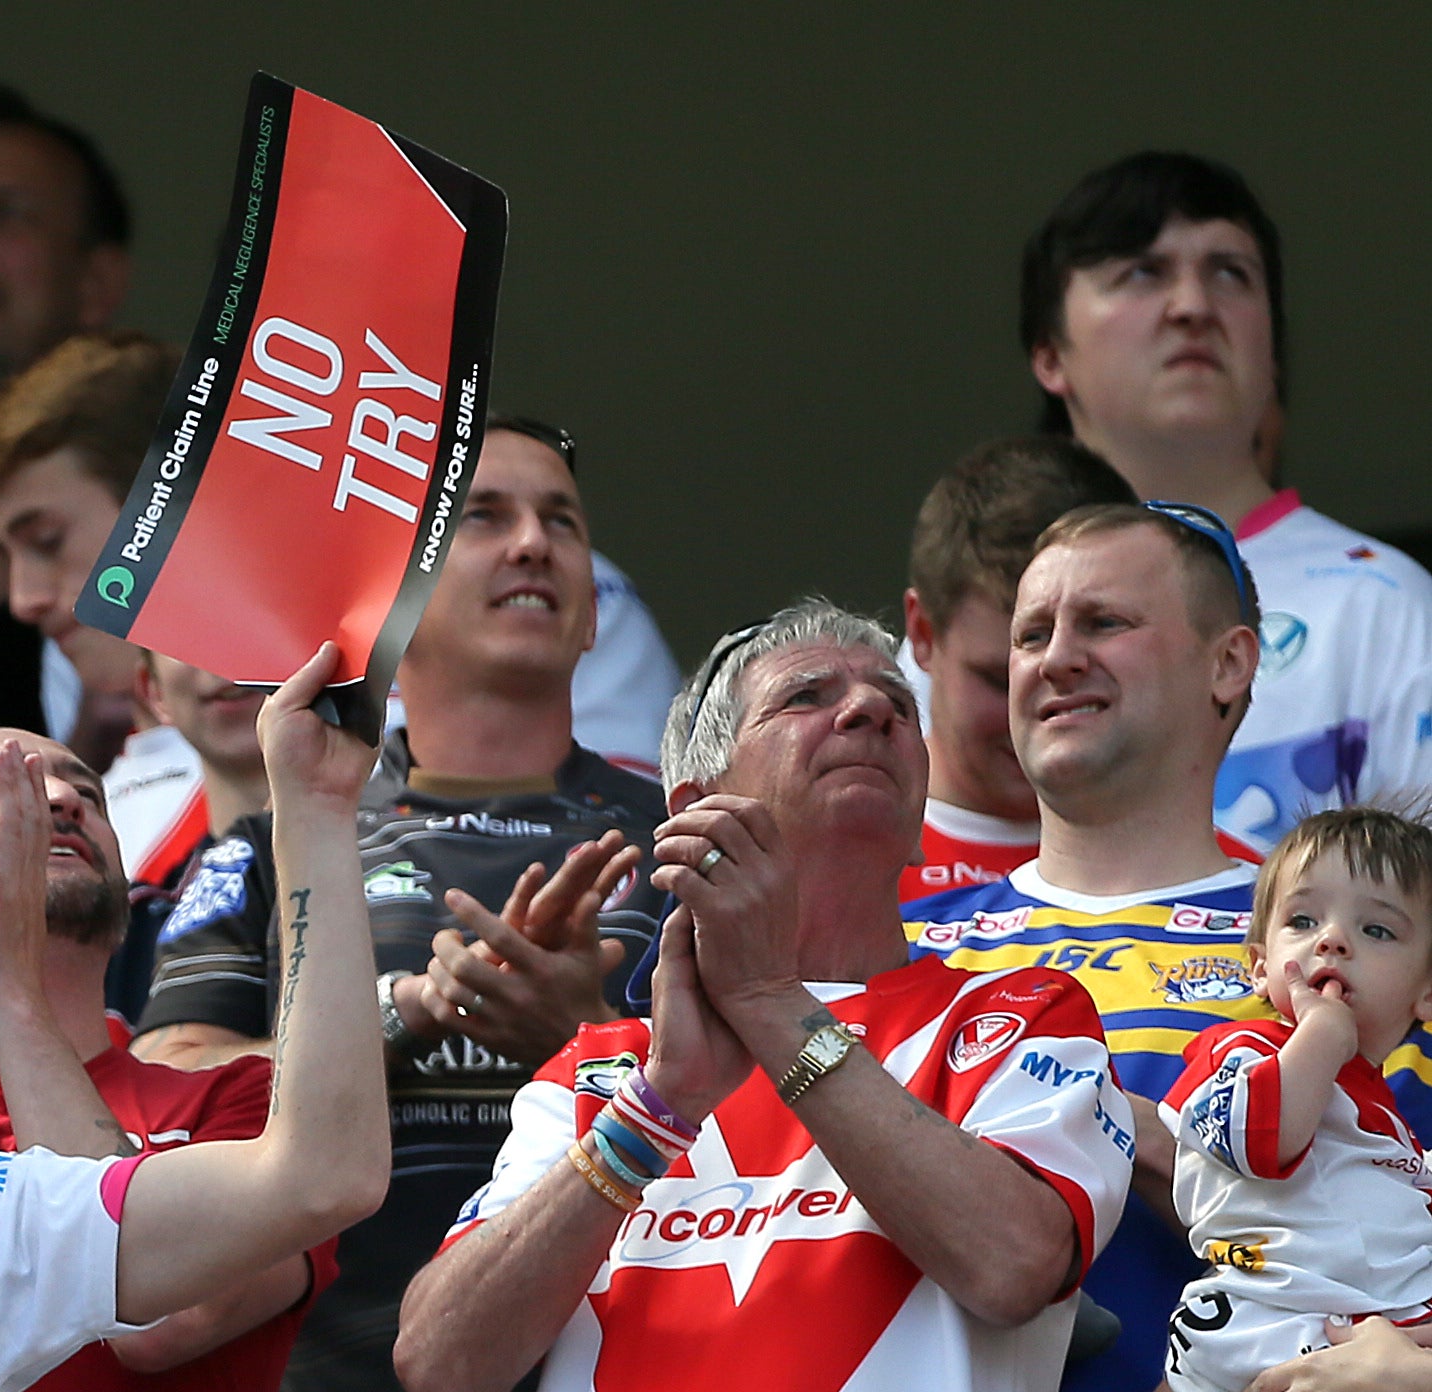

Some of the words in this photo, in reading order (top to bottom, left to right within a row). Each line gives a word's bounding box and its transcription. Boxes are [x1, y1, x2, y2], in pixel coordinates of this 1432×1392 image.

[213, 281, 245, 345] MEDICAL
[233, 192, 263, 280] NEGLIGENCE
[251, 105, 276, 191] SPECIALISTS
[121, 480, 174, 562] Patient
[159, 406, 203, 481] Claim
[186, 357, 220, 406] Line
[227, 316, 345, 472] NO
[333, 328, 442, 524] TRY
[419, 492, 453, 573] KNOW
[443, 444, 469, 493] FOR
[456, 363, 479, 442] SURE...
